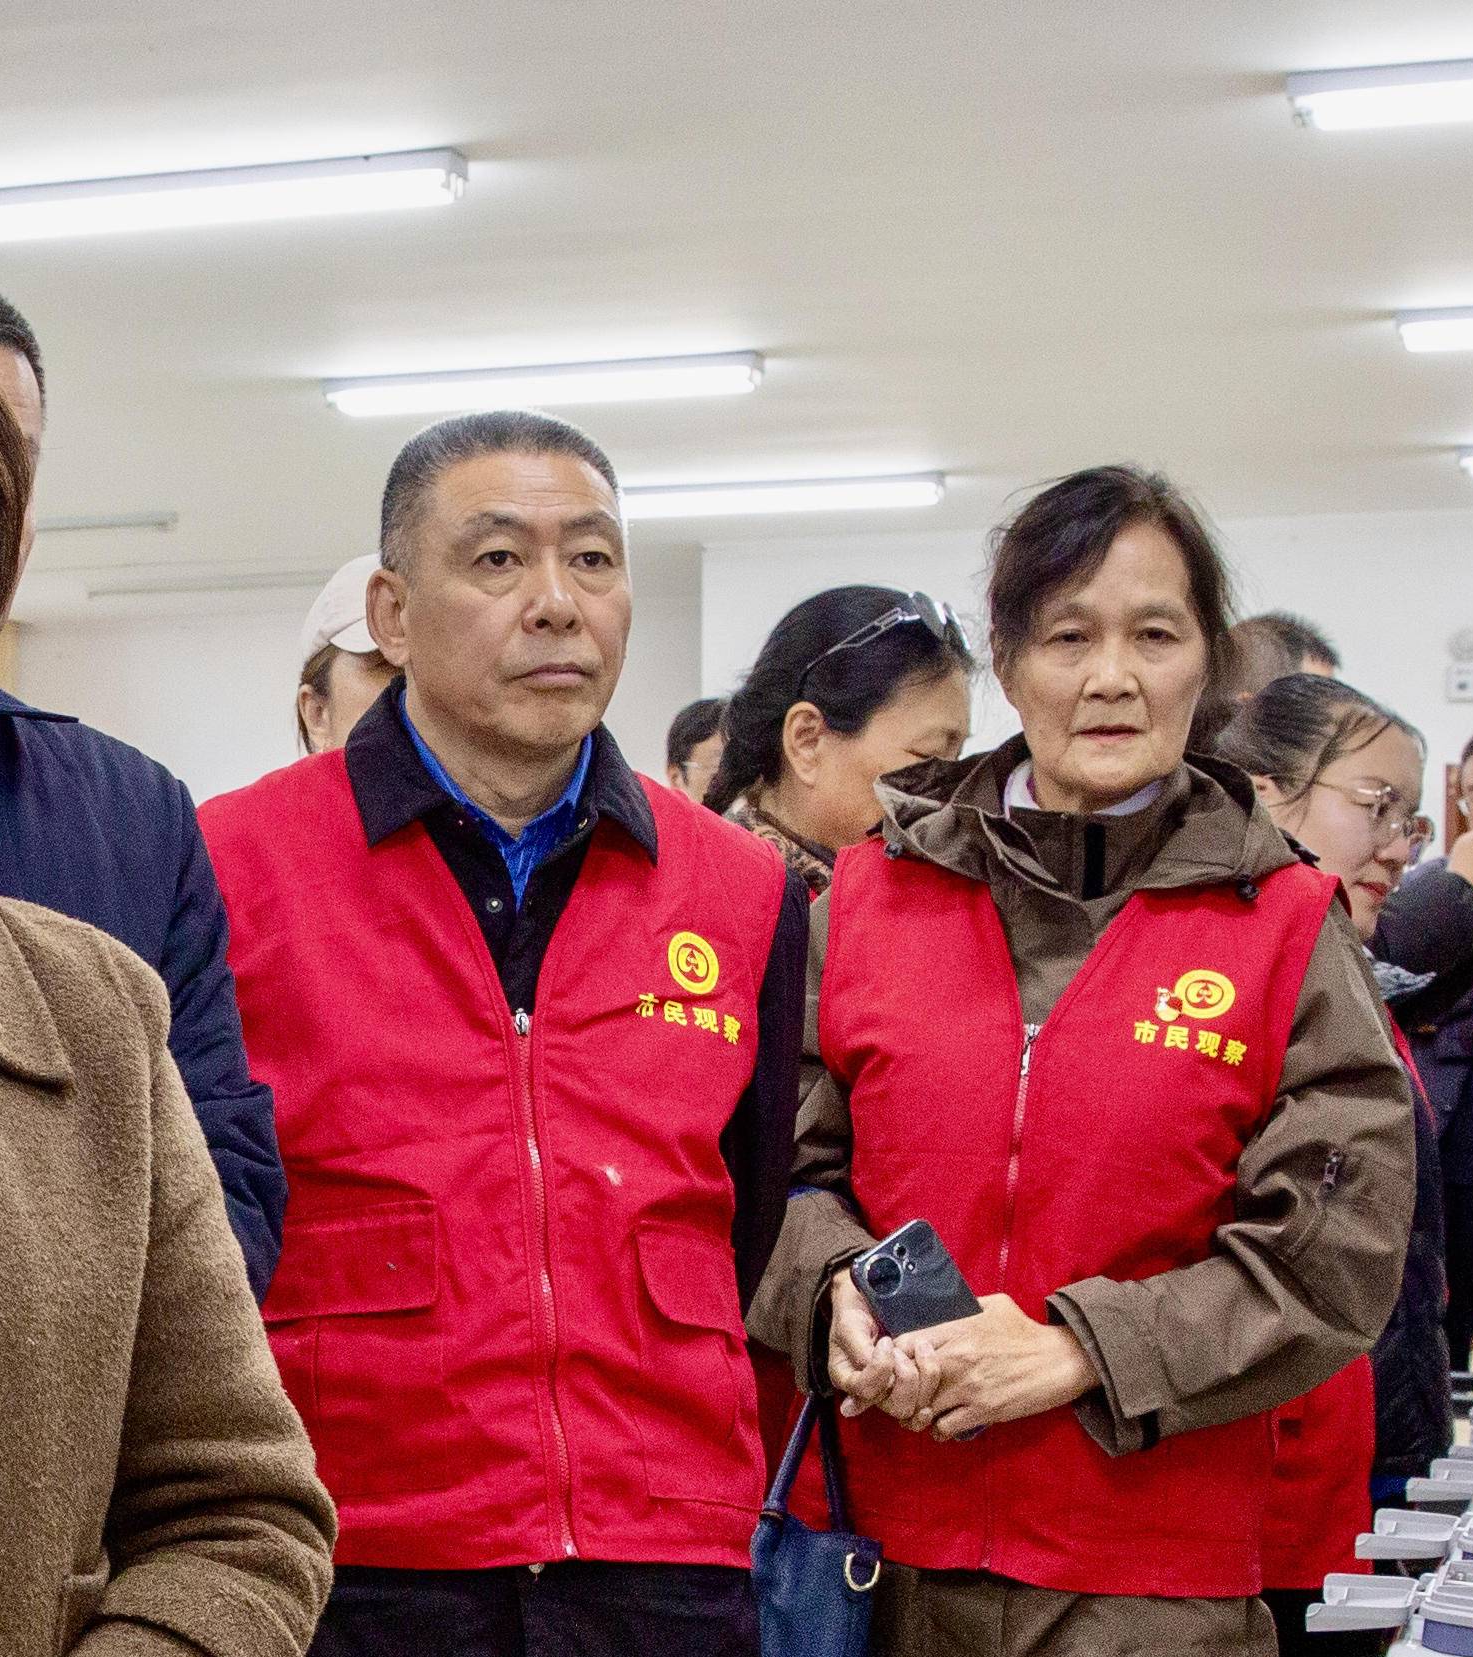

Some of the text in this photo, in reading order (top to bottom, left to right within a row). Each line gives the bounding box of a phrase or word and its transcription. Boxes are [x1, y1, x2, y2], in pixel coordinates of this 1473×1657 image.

[635, 993, 742, 1046] 市民观察
[1133, 1019, 1248, 1067] 市民观察
